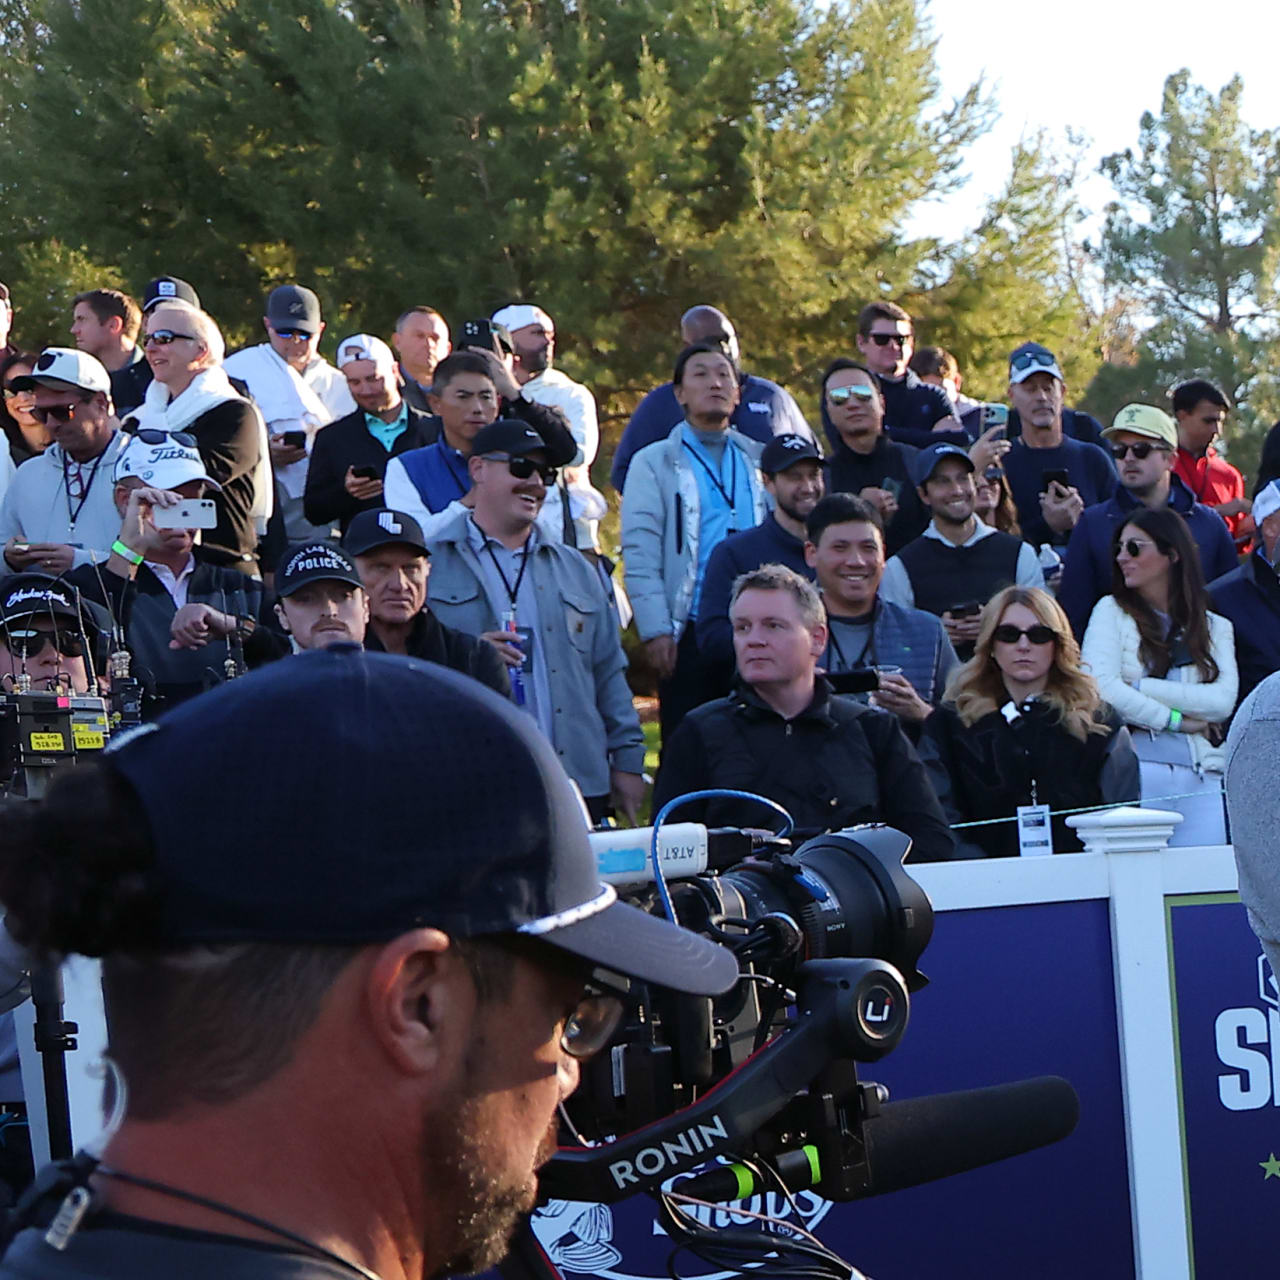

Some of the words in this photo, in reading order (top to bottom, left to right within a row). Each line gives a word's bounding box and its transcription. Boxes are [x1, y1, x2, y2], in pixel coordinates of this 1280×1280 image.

[306, 545, 326, 554] LAS
[298, 556, 340, 572] POLICE
[663, 846, 695, 861] AT&T
[609, 1115, 728, 1190] RONIN
